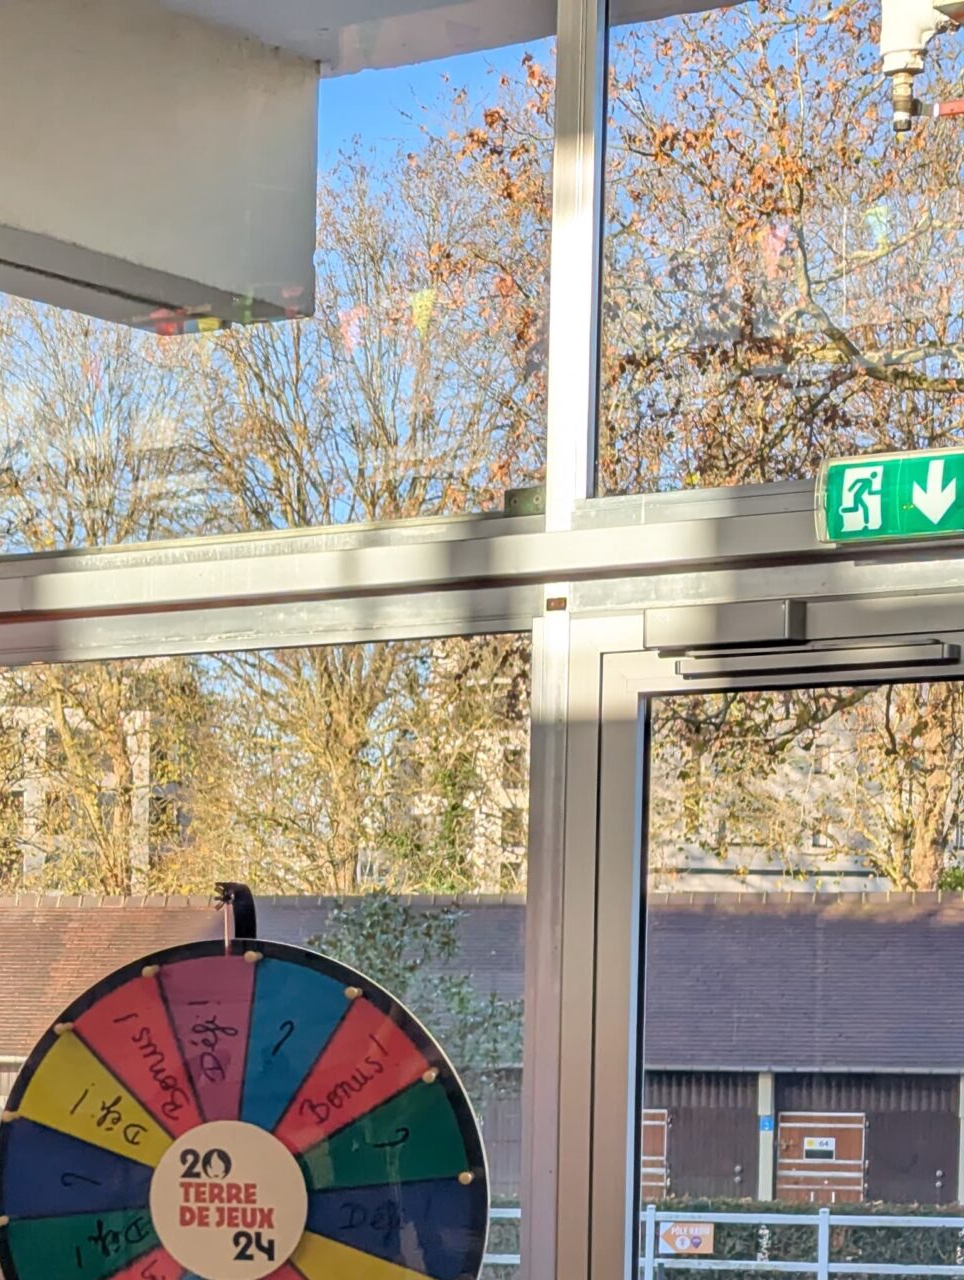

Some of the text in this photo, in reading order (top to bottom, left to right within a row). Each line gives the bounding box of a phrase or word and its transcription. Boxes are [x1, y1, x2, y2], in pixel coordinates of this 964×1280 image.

[179, 1181, 257, 1204] TERRE
[179, 1206, 274, 1229] DE JEUX
[233, 1231, 275, 1261] 24
